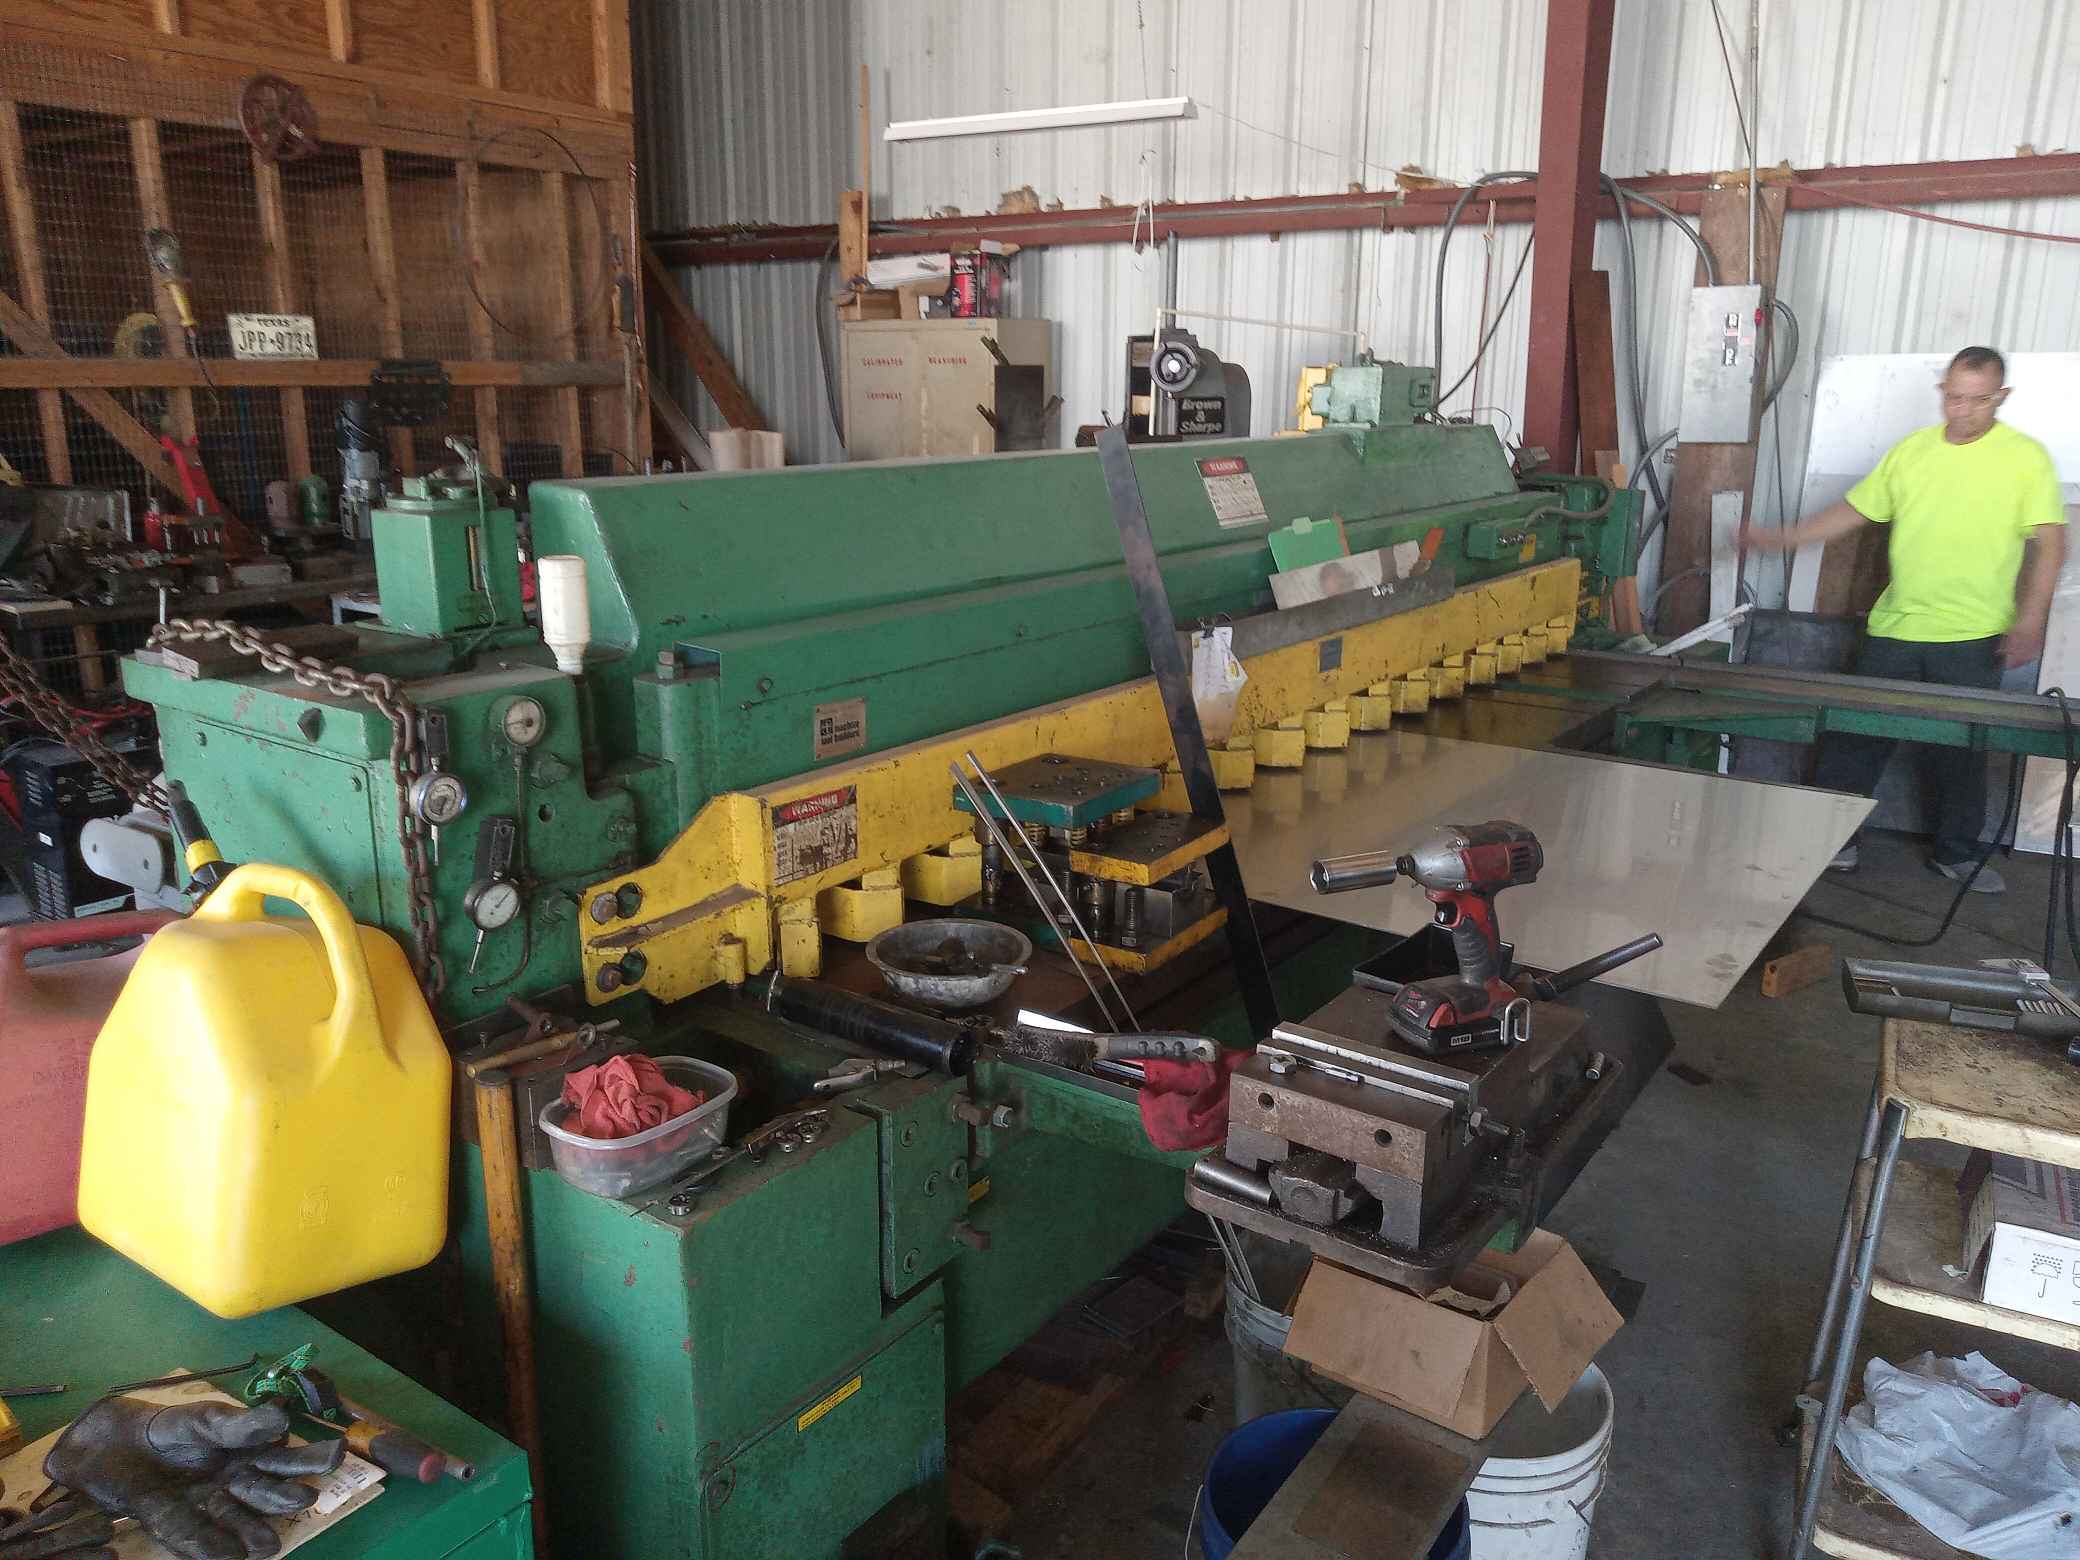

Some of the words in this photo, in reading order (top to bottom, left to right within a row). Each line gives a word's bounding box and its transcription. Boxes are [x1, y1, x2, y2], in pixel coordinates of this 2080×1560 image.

[256, 318, 290, 328] TEXAS
[1182, 399, 1222, 410] Brown
[1180, 420, 1222, 433] Sharpe
